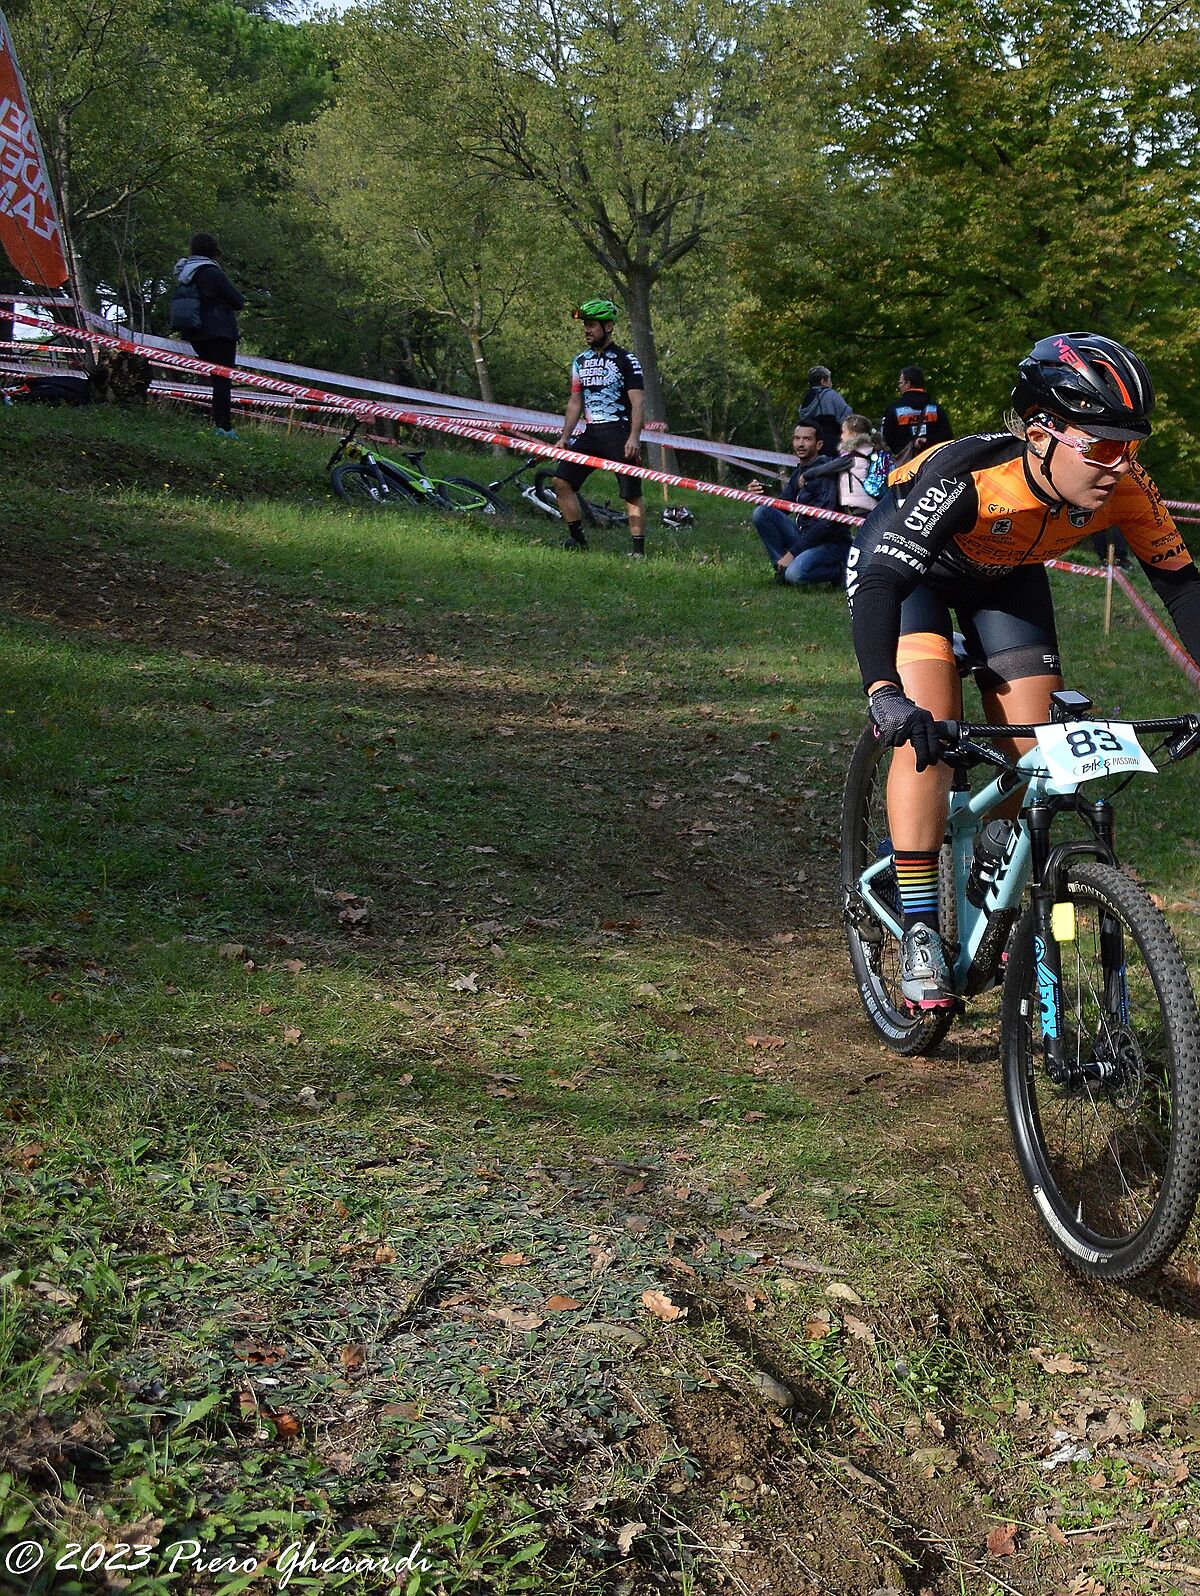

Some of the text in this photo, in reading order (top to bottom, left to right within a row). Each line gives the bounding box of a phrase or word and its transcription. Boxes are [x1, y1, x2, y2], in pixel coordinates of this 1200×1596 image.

[1053, 338, 1088, 372] MET
[133, 346, 216, 373] SPECIALIZED
[229, 370, 311, 396] SPECIALIZED
[322, 393, 403, 419] SPECIALIZED
[416, 416, 497, 442] SPECIALIZED
[509, 438, 591, 464] SPECIALIZED
[602, 460, 683, 486] SPECIALIZED
[695, 481, 776, 506] SPECIALIZED
[904, 480, 951, 531] crea
[937, 481, 967, 517] PREMISCELATI
[1066, 729, 1123, 758] 83
[1082, 757, 1111, 774] BIKE
